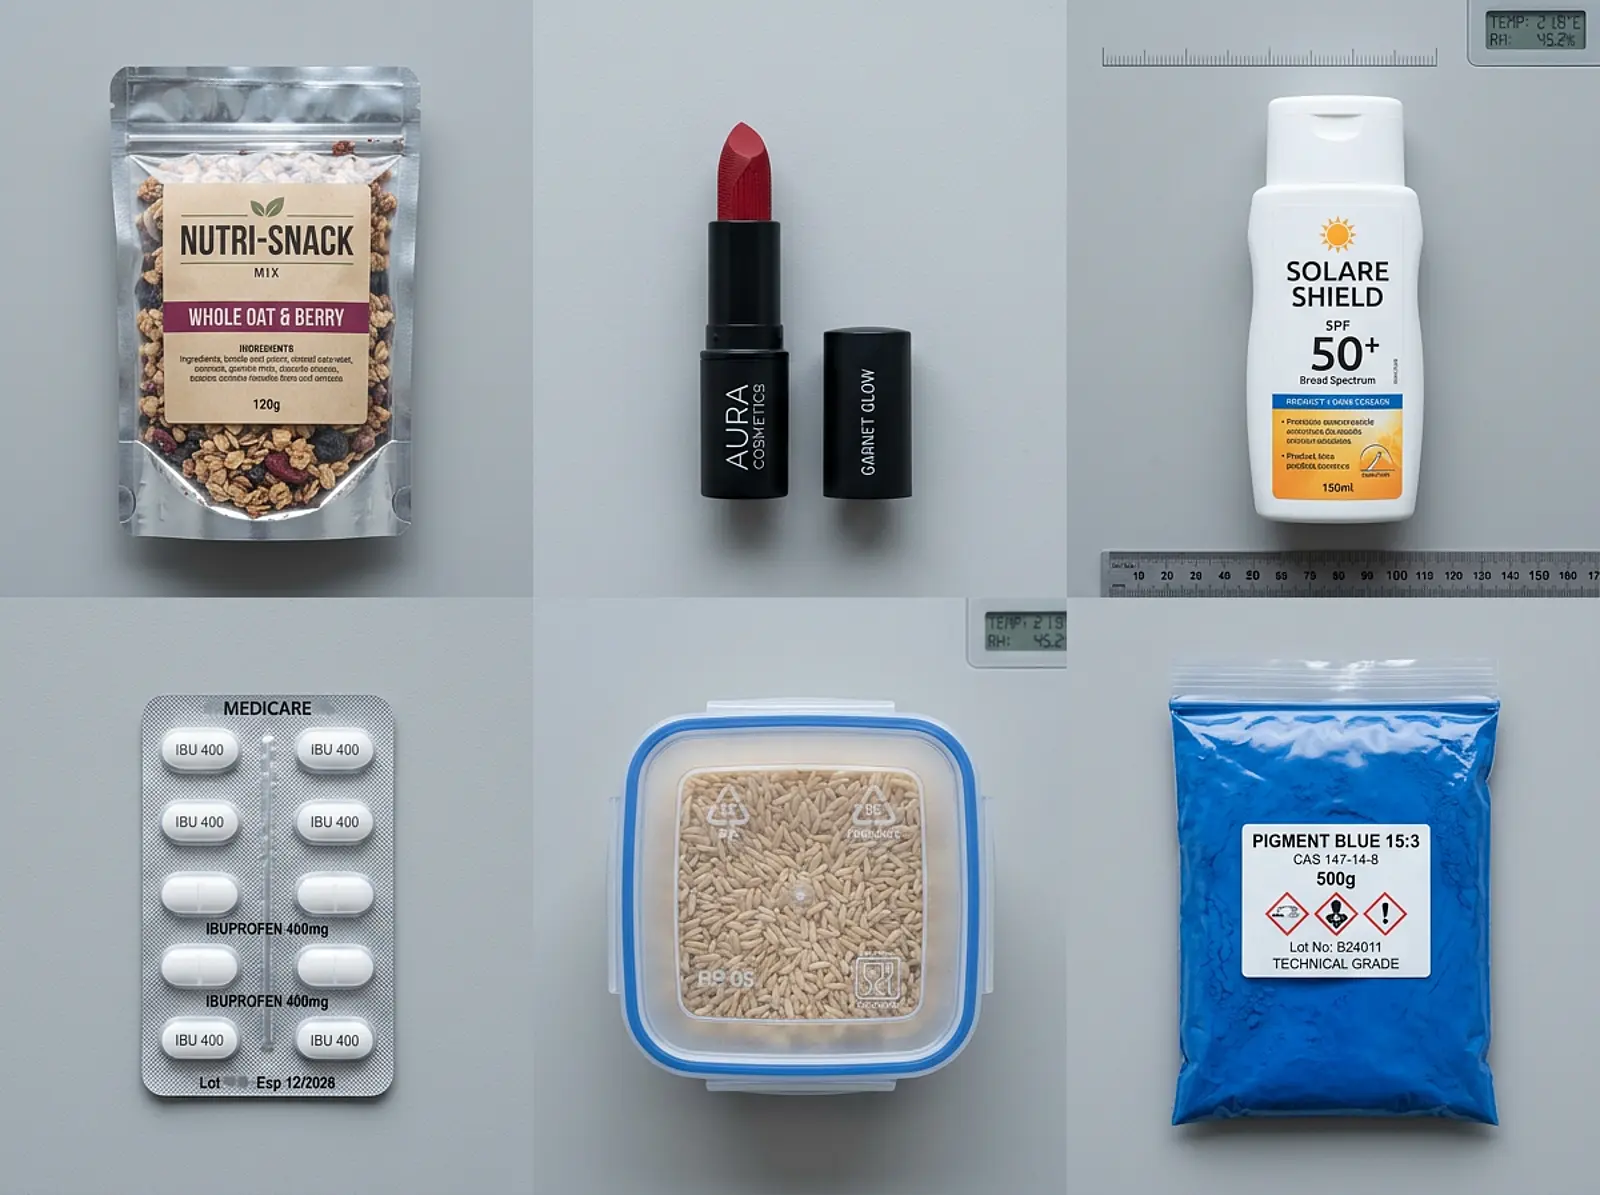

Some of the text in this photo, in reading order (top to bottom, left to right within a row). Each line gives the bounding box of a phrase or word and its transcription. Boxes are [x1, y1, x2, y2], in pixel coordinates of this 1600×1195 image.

[180, 225, 354, 256] NUTRI-SNACK
[254, 268, 279, 278] MIX
[1287, 261, 1389, 282] SOLARE
[1292, 287, 1383, 308] SHIELD
[188, 308, 345, 326] WHOLE OAT & BERRY
[1326, 320, 1350, 331] SPF
[1311, 336, 1379, 371] 50+
[1330, 376, 1376, 386] Spectrum
[253, 399, 280, 412] 120g
[725, 384, 749, 470] AURA
[752, 383, 765, 470] COSMETICS
[861, 368, 875, 476] GARNET GLOW
[1323, 483, 1354, 492] 150ml
[1161, 571, 1173, 580] 20
[1387, 570, 1408, 580] 100
[1445, 571, 1463, 580] 120
[1529, 570, 1549, 580] 150
[223, 701, 312, 716] MEDICARE
[175, 744, 224, 756] IBU 400
[311, 744, 359, 756] IBU 400
[175, 816, 224, 828] IBU 400
[311, 816, 359, 828] IBU 400
[1252, 834, 1420, 848] PIGMENT BLUE 15:3
[1293, 854, 1379, 865] CAS 147-14-8
[1316, 871, 1356, 889] 500g
[206, 923, 329, 938] IBUPROFEN 400mg
[1289, 942, 1381, 953] Lot No: B24011
[1273, 958, 1399, 969] TECHNICAL GRADE
[206, 995, 329, 1010] IBUPROFEN 400mg
[175, 1034, 224, 1046] IBU 400
[311, 1034, 359, 1046] IBU 400
[200, 1076, 336, 1091] Lot Esp 12/2028
